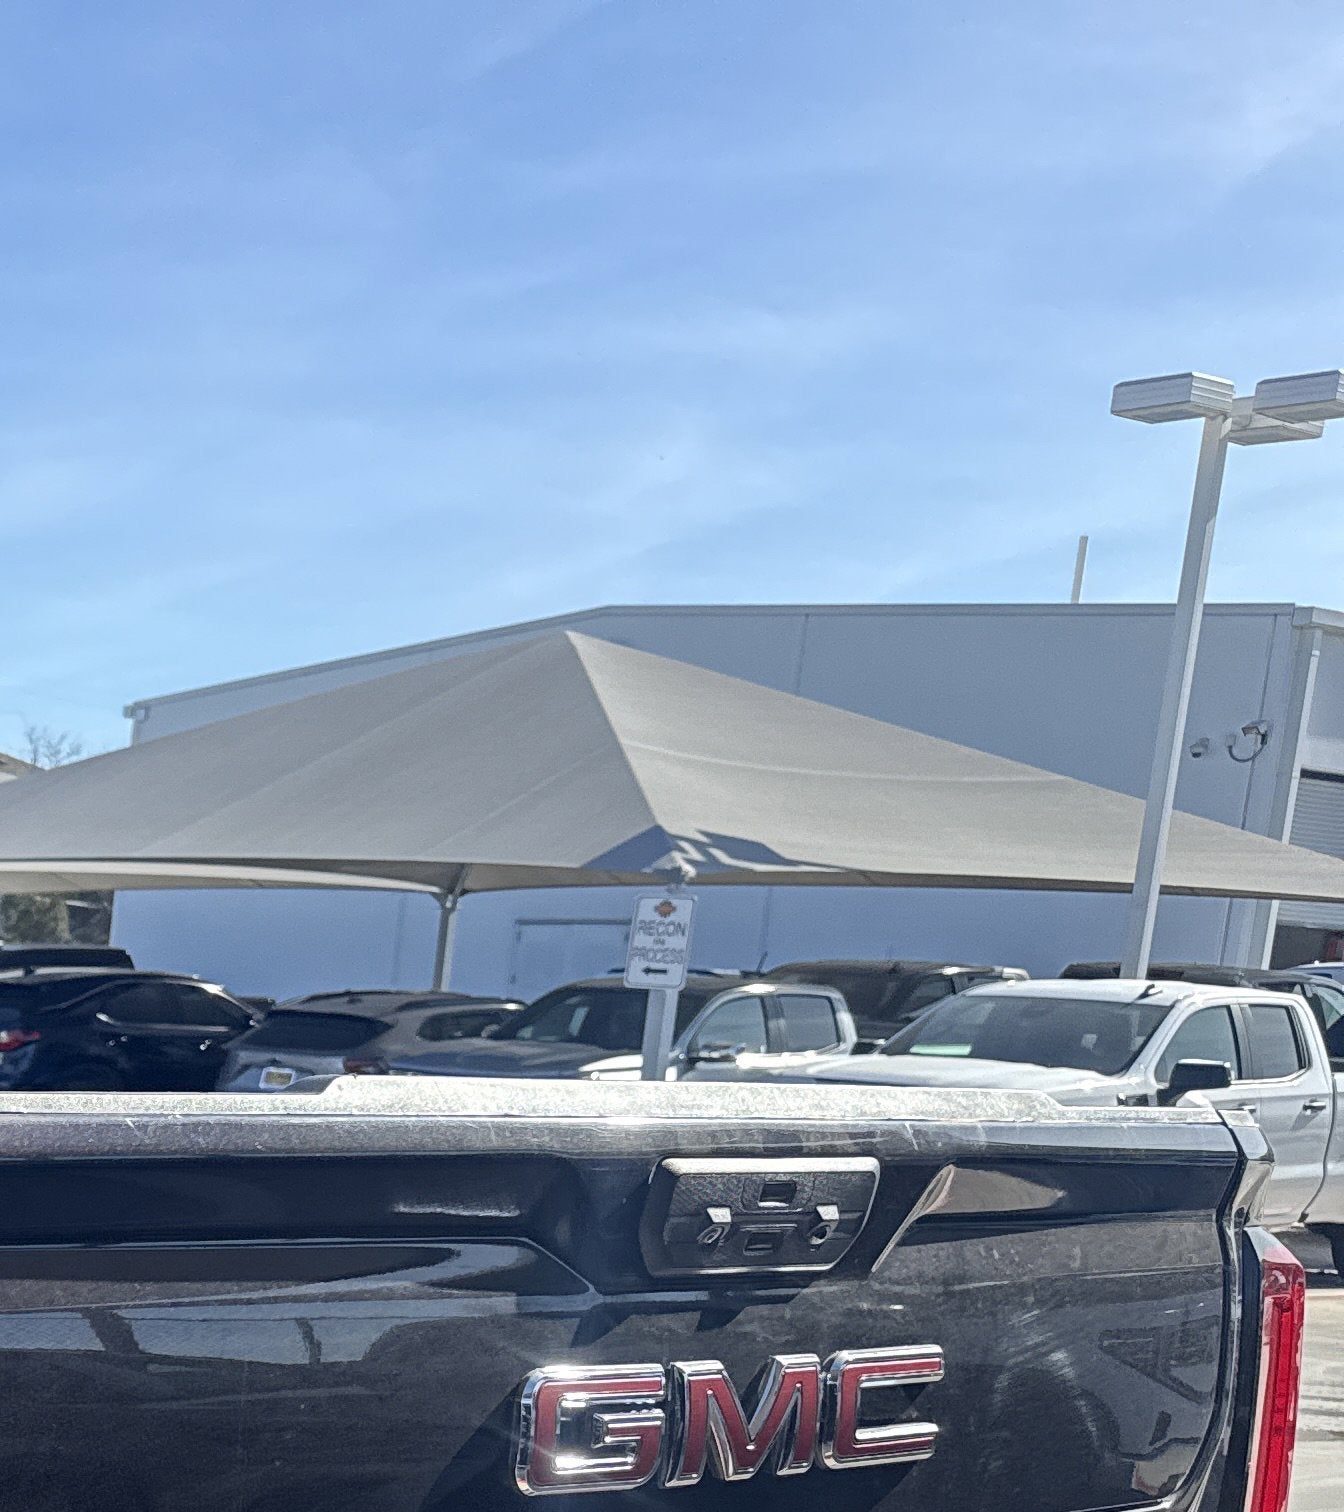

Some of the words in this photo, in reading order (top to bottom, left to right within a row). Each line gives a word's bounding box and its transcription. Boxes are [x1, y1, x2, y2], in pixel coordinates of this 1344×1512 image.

[637, 919, 688, 937] RECON
[652, 938, 666, 946] IN
[515, 1344, 945, 1496] GMC
